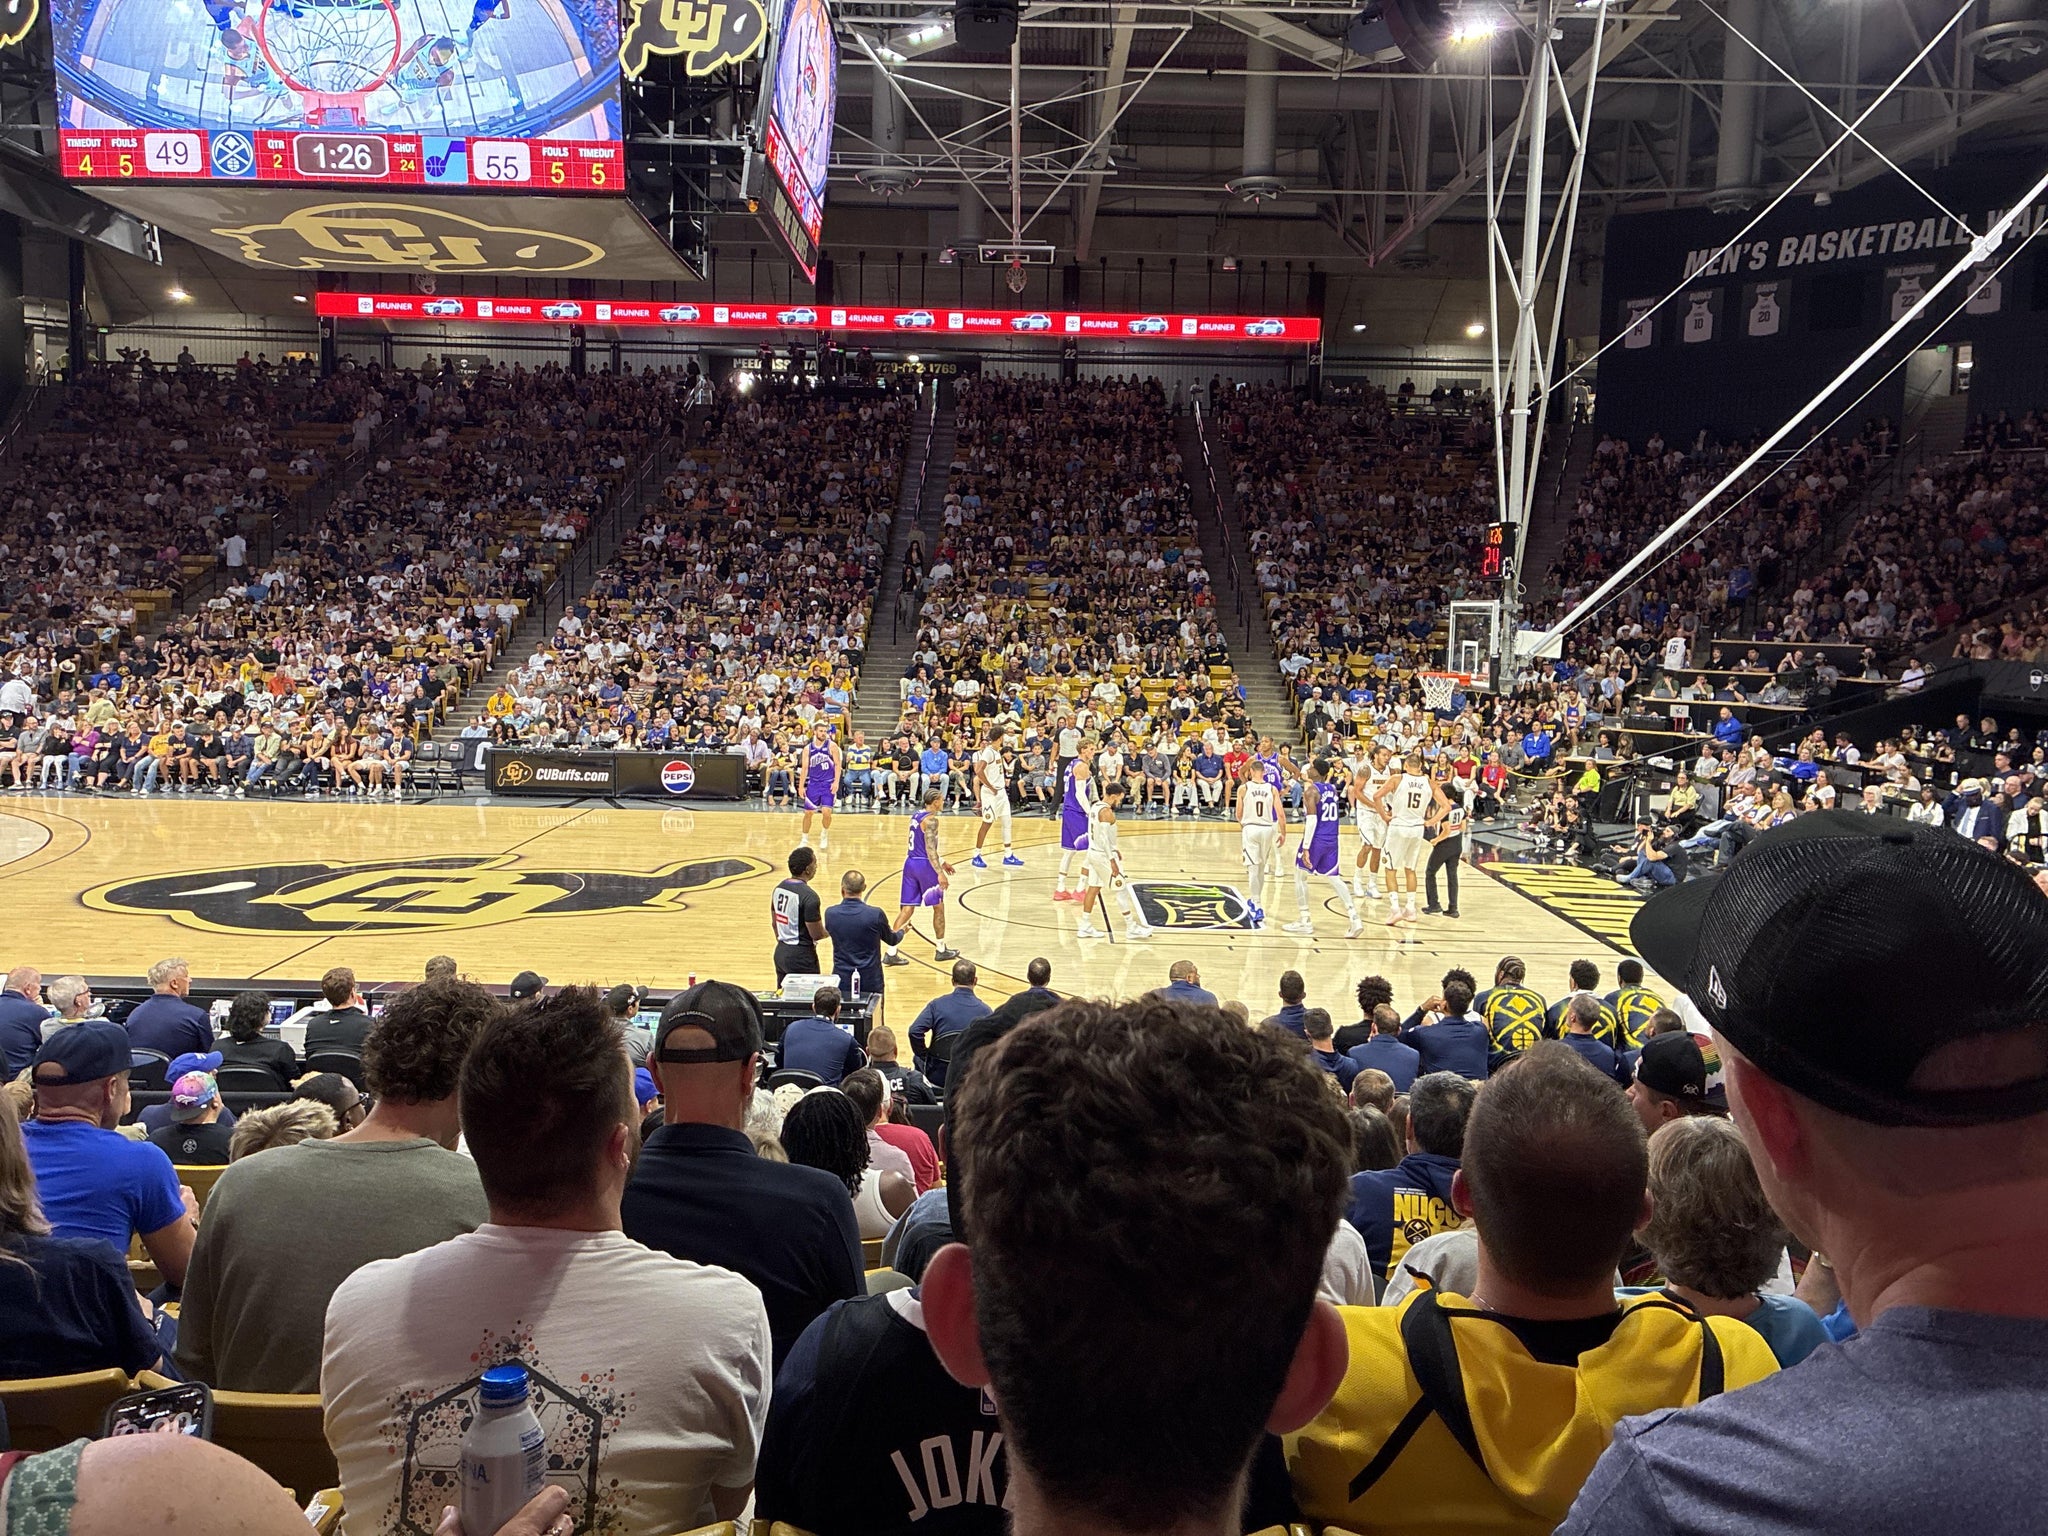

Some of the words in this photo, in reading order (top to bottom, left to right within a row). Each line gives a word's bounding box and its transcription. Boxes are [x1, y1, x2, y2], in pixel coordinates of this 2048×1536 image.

[66, 138, 101, 148] TIMEOUT
[111, 138, 138, 148] FOULS
[268, 139, 285, 150] QTR
[393, 143, 416, 153] SHOT
[156, 141, 189, 165] 49
[313, 142, 372, 170] 1:26
[542, 146, 569, 157] FOULS
[578, 148, 615, 159] TIMEOUT
[79, 155, 93, 175] 4
[119, 155, 133, 176] 5
[273, 154, 283, 168] 2
[400, 160, 415, 171] 24
[486, 156, 518, 179] 55
[551, 162, 565, 184] 5
[591, 163, 606, 185] 5
[1682, 241, 1769, 279] MEN'S
[1777, 213, 1971, 267] BASKETBALL
[375, 302, 412, 311] 4RUNNER
[495, 305, 532, 314] 4RUNNER
[613, 308, 650, 317] 4RUNNER
[731, 311, 768, 320] 4RUNNER
[848, 314, 885, 323] 4RUNNER
[965, 317, 1002, 326] 4RUNNER
[1757, 310, 1771, 323] 20
[1082, 320, 1119, 329] 4RUNNER
[1199, 323, 1236, 332] 4RUNNER
[1693, 318, 1704, 330] 10
[1483, 546, 1500, 575] 24
[535, 768, 609, 782] CUBuffs.com
[663, 773, 692, 781] PEPSI
[1407, 792, 1422, 809] 15
[1256, 800, 1264, 818] 0
[1321, 802, 1338, 822] 20
[890, 1430, 1015, 1523] JOK
